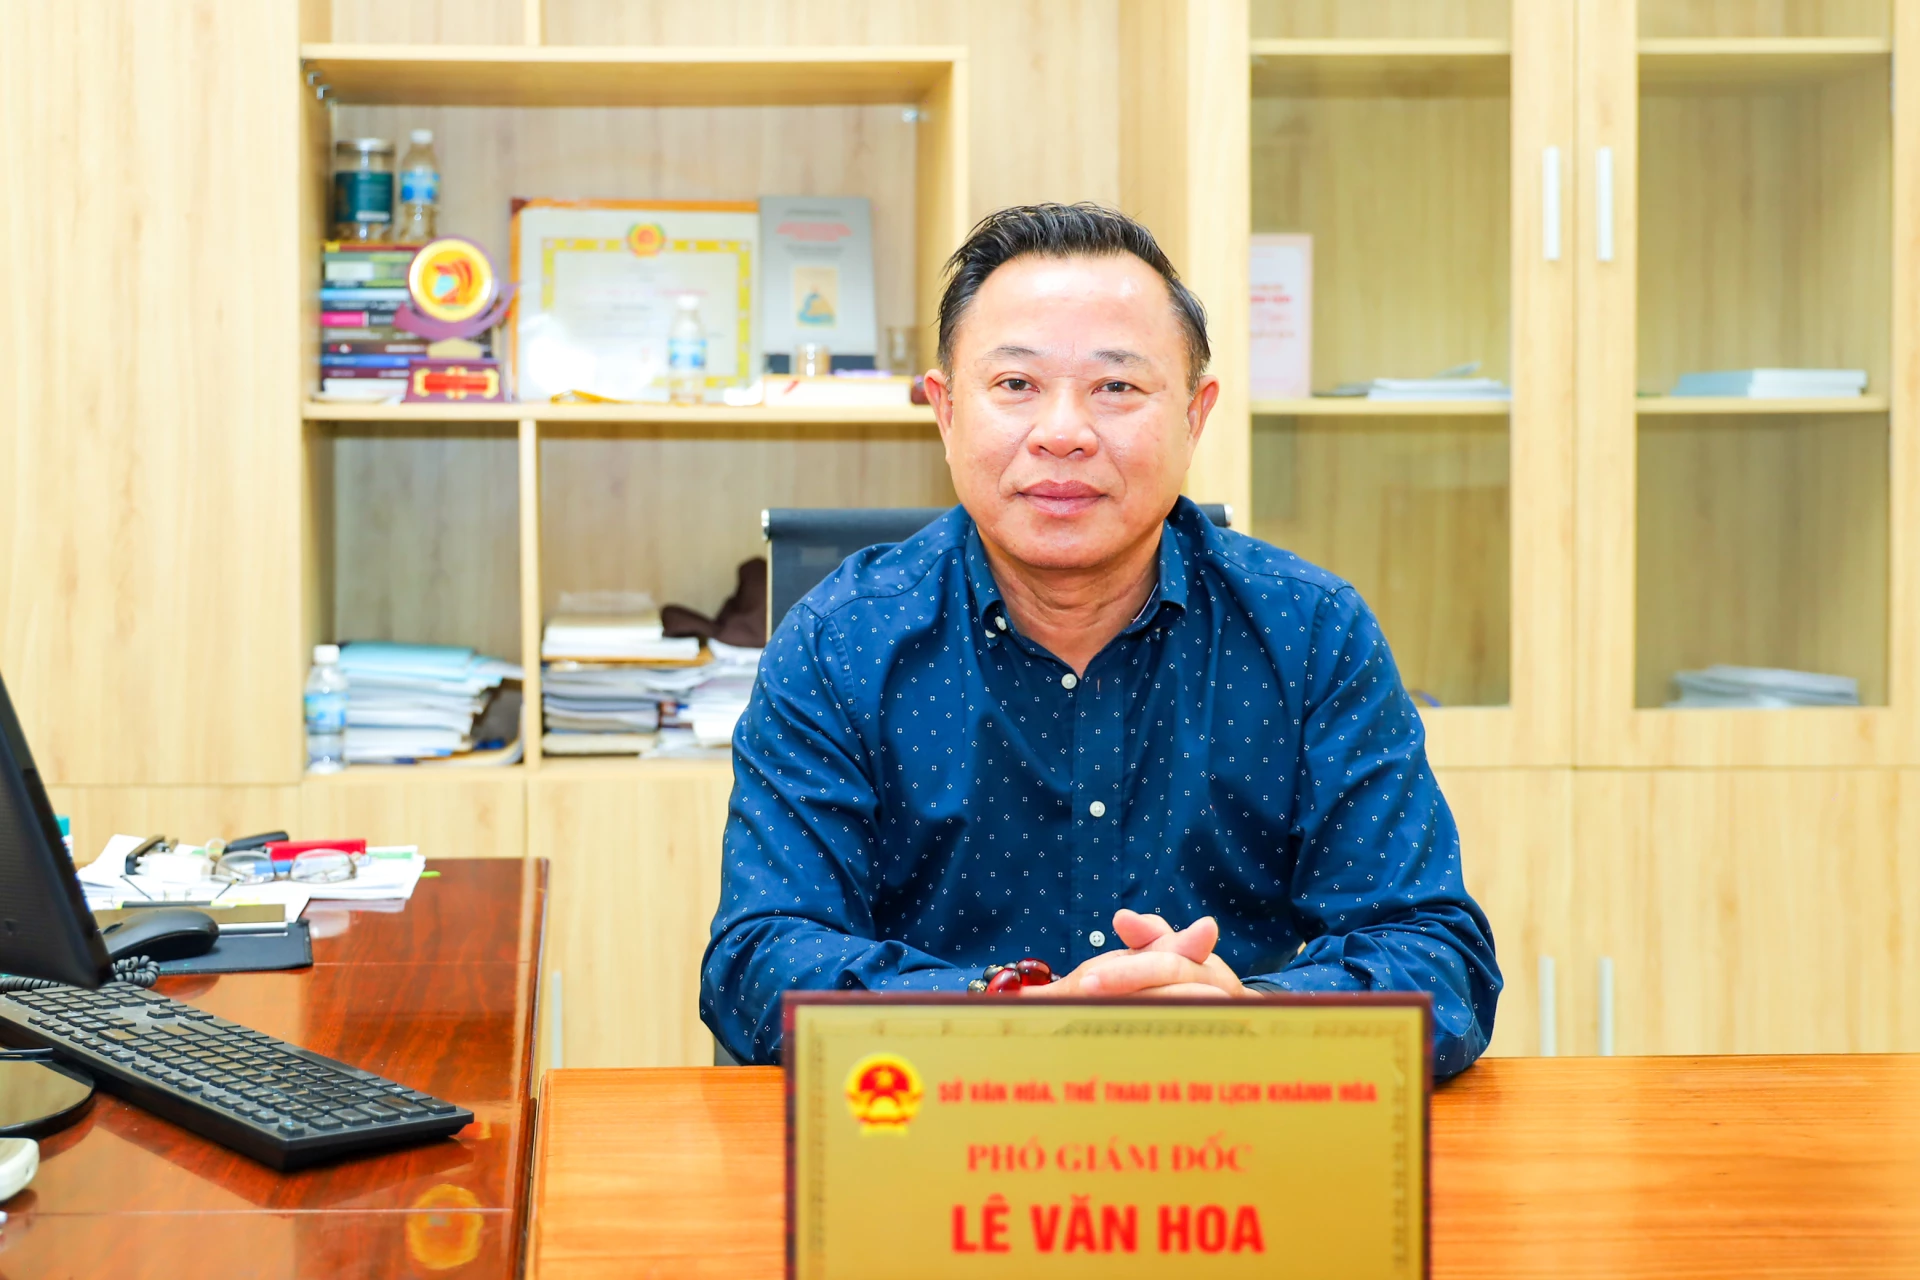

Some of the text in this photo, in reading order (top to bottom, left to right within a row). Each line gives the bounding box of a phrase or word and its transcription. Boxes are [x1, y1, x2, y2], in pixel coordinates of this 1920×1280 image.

[1103, 1081, 1153, 1105] THAO
[1187, 1082, 1216, 1104] DU
[1218, 1082, 1264, 1107] LỊCH
[1265, 1079, 1335, 1104] KHÁNH
[967, 1131, 1254, 1174] PHÓ GIÁM ĐỐC
[950, 1192, 1268, 1257] LÊ VĂN HOA
